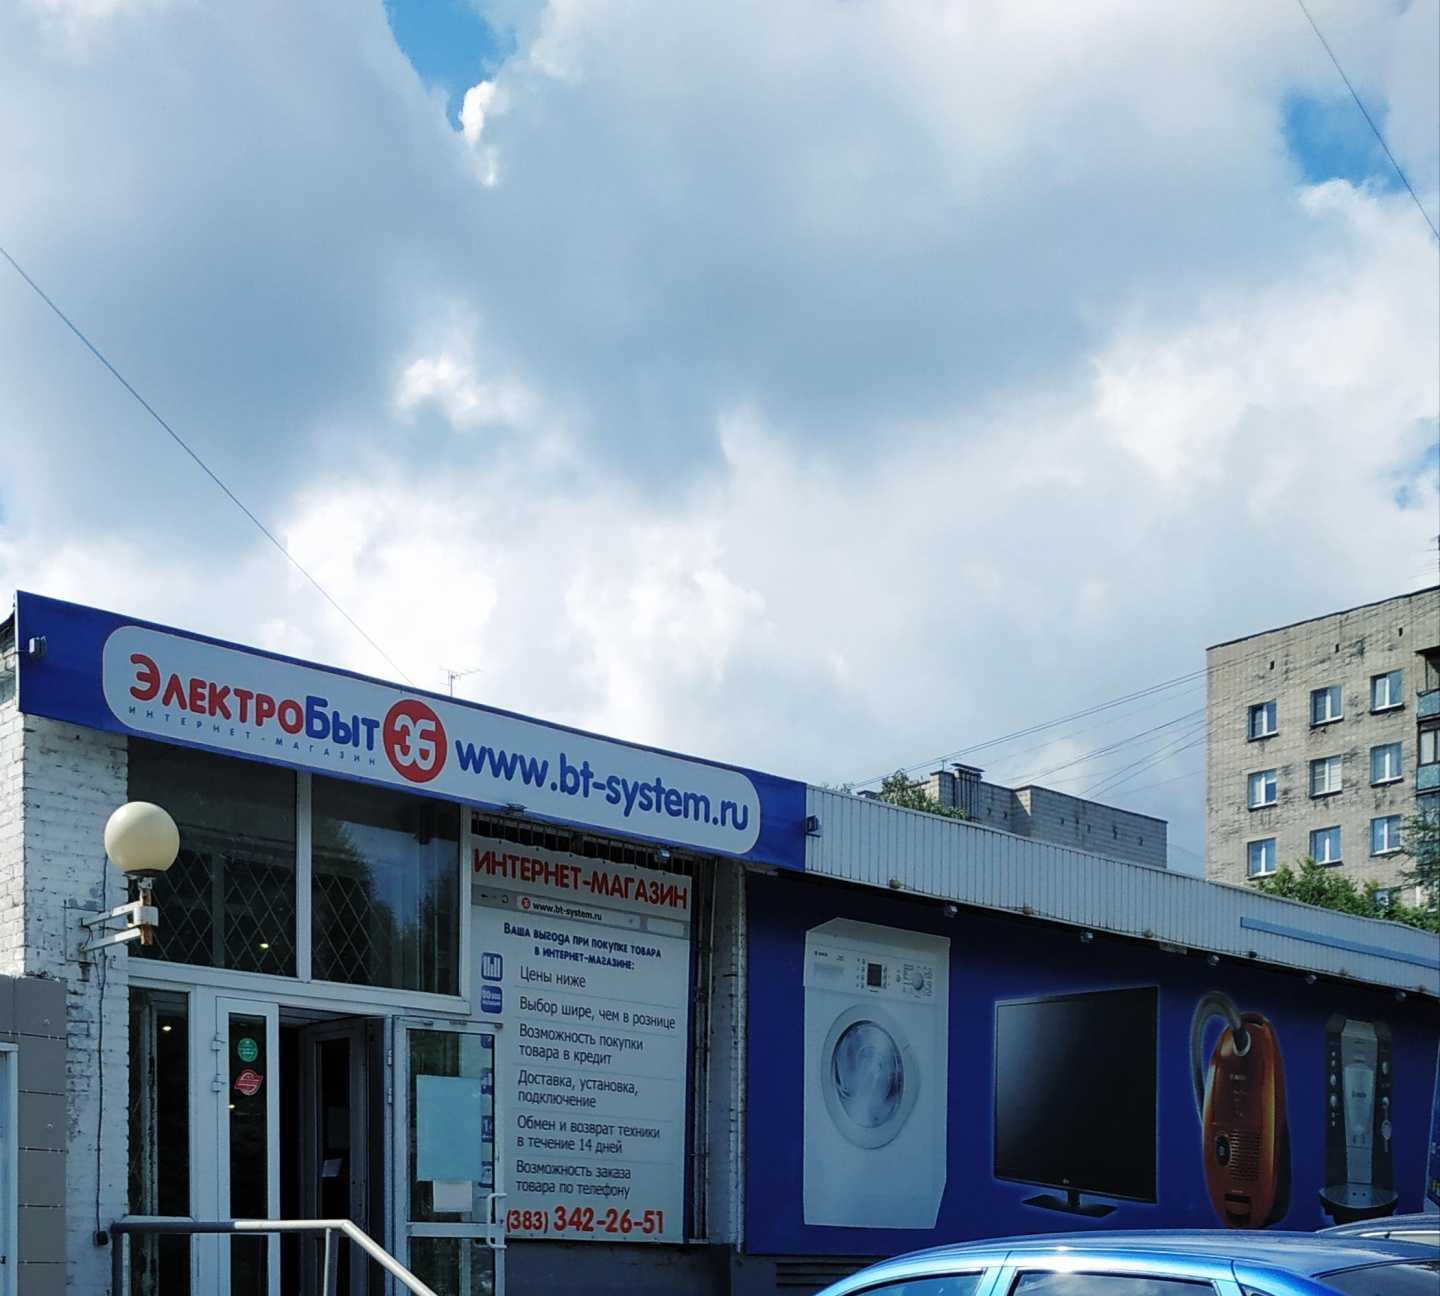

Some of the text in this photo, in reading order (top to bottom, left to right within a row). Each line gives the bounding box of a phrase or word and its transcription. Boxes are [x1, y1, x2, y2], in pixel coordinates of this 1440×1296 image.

[129, 706, 376, 766] ИНТЕРНЕТ-МАГАЗИН
[455, 740, 749, 831] www.bt-system.ru
[474, 848, 688, 910] ИНТЕРНЕТ-МАГАЗИН
[532, 901, 602, 921] www.bt-system.ru
[520, 965, 586, 988] Цены ниже
[519, 996, 558, 1016] Выбор
[562, 1004, 595, 1021] шире,
[599, 1009, 620, 1021] чем
[623, 1013, 630, 1023] в
[633, 1014, 676, 1030] рознице
[519, 1023, 644, 1051] Возможность покупки
[519, 1044, 613, 1066] товара в кредит
[518, 1069, 639, 1096] Доставка, установка,
[518, 1091, 597, 1108] подключение
[517, 1115, 661, 1139] Обмен и возврат техники
[517, 1137, 623, 1155] в течение 14 дней
[516, 1160, 631, 1180] Возможность заказа
[516, 1180, 630, 1200] товара по телефону
[506, 1206, 664, 1234] (383) 342-26-51
